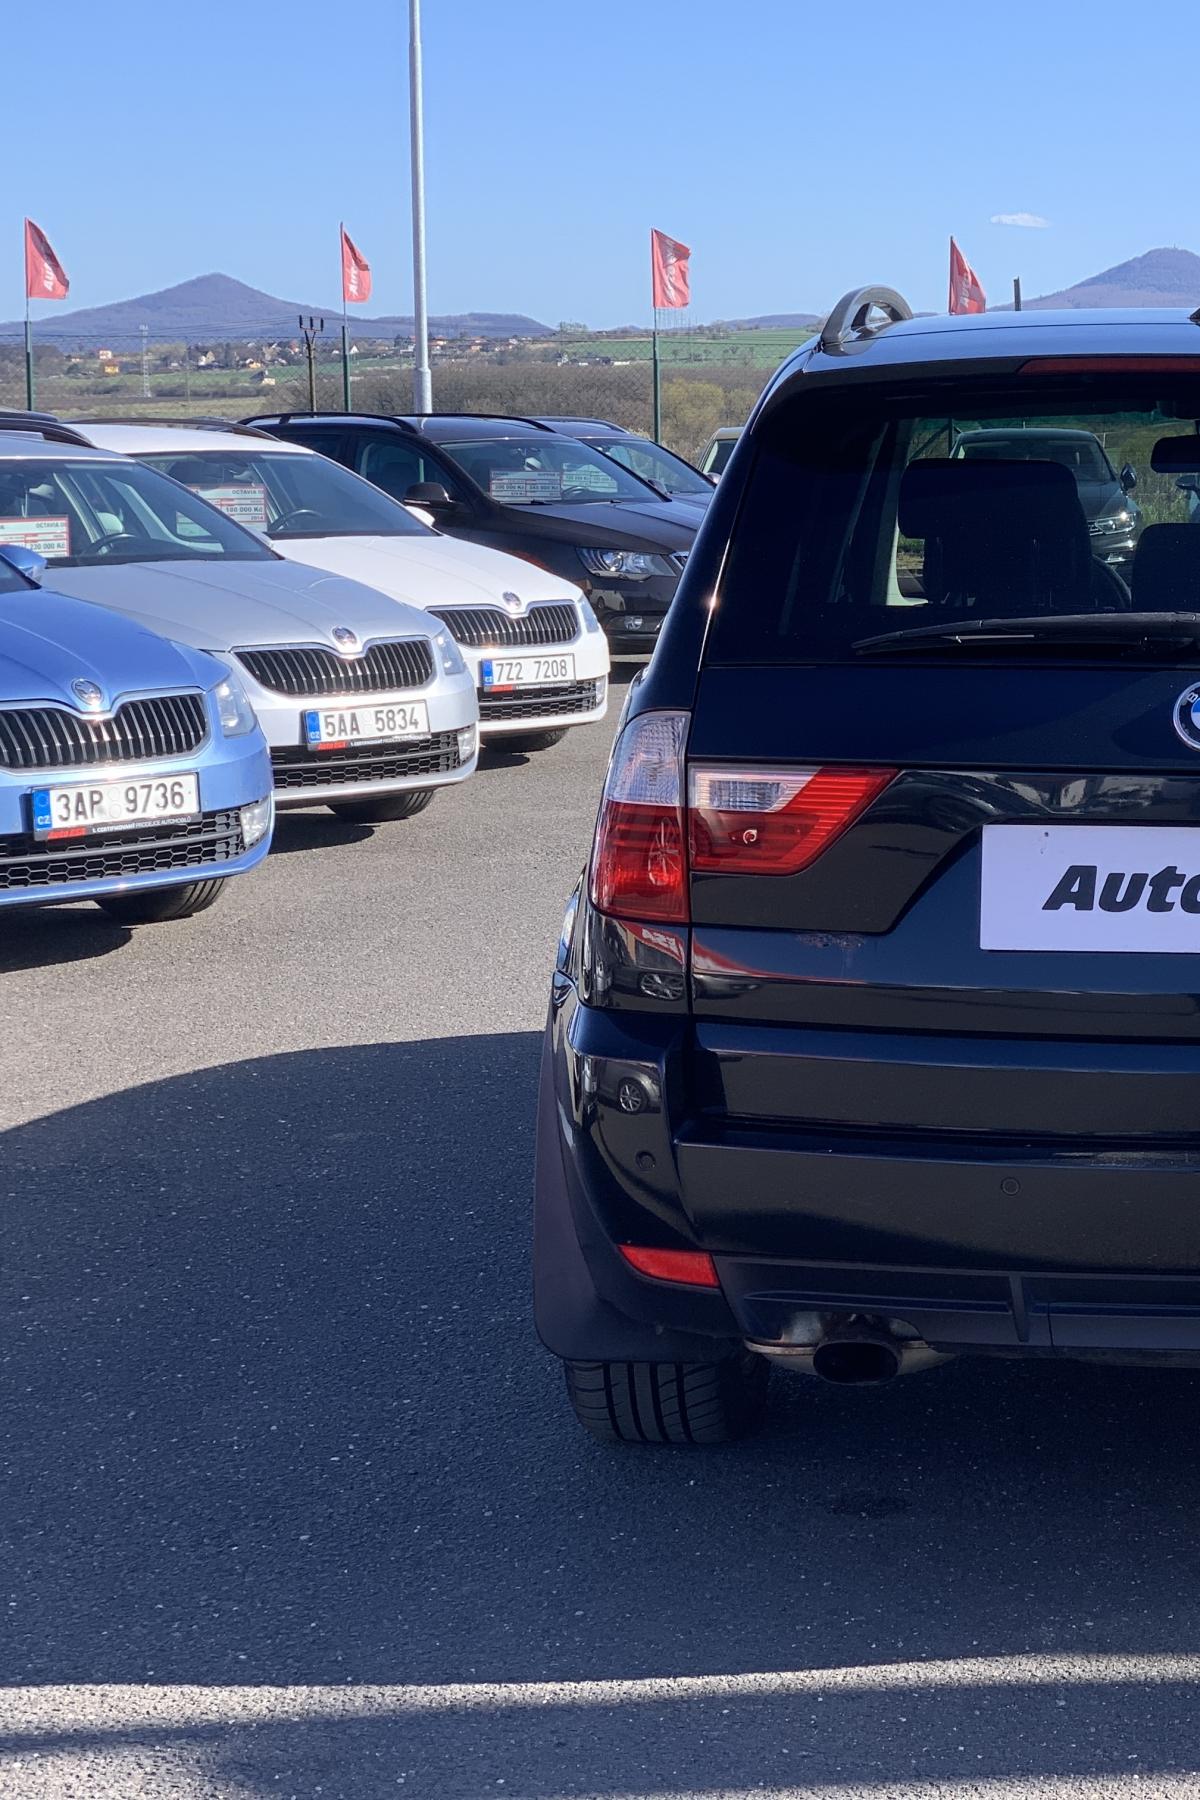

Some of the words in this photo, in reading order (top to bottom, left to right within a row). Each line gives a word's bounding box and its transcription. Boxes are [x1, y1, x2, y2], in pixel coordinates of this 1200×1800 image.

[496, 662, 523, 682] 7Z2
[534, 659, 567, 679] 7208
[310, 731, 320, 739] CZ
[324, 712, 360, 738] 5AA
[374, 706, 419, 732] 5834
[37, 815, 50, 825] CZ
[57, 789, 103, 822] 3AP
[125, 781, 185, 813] 9736
